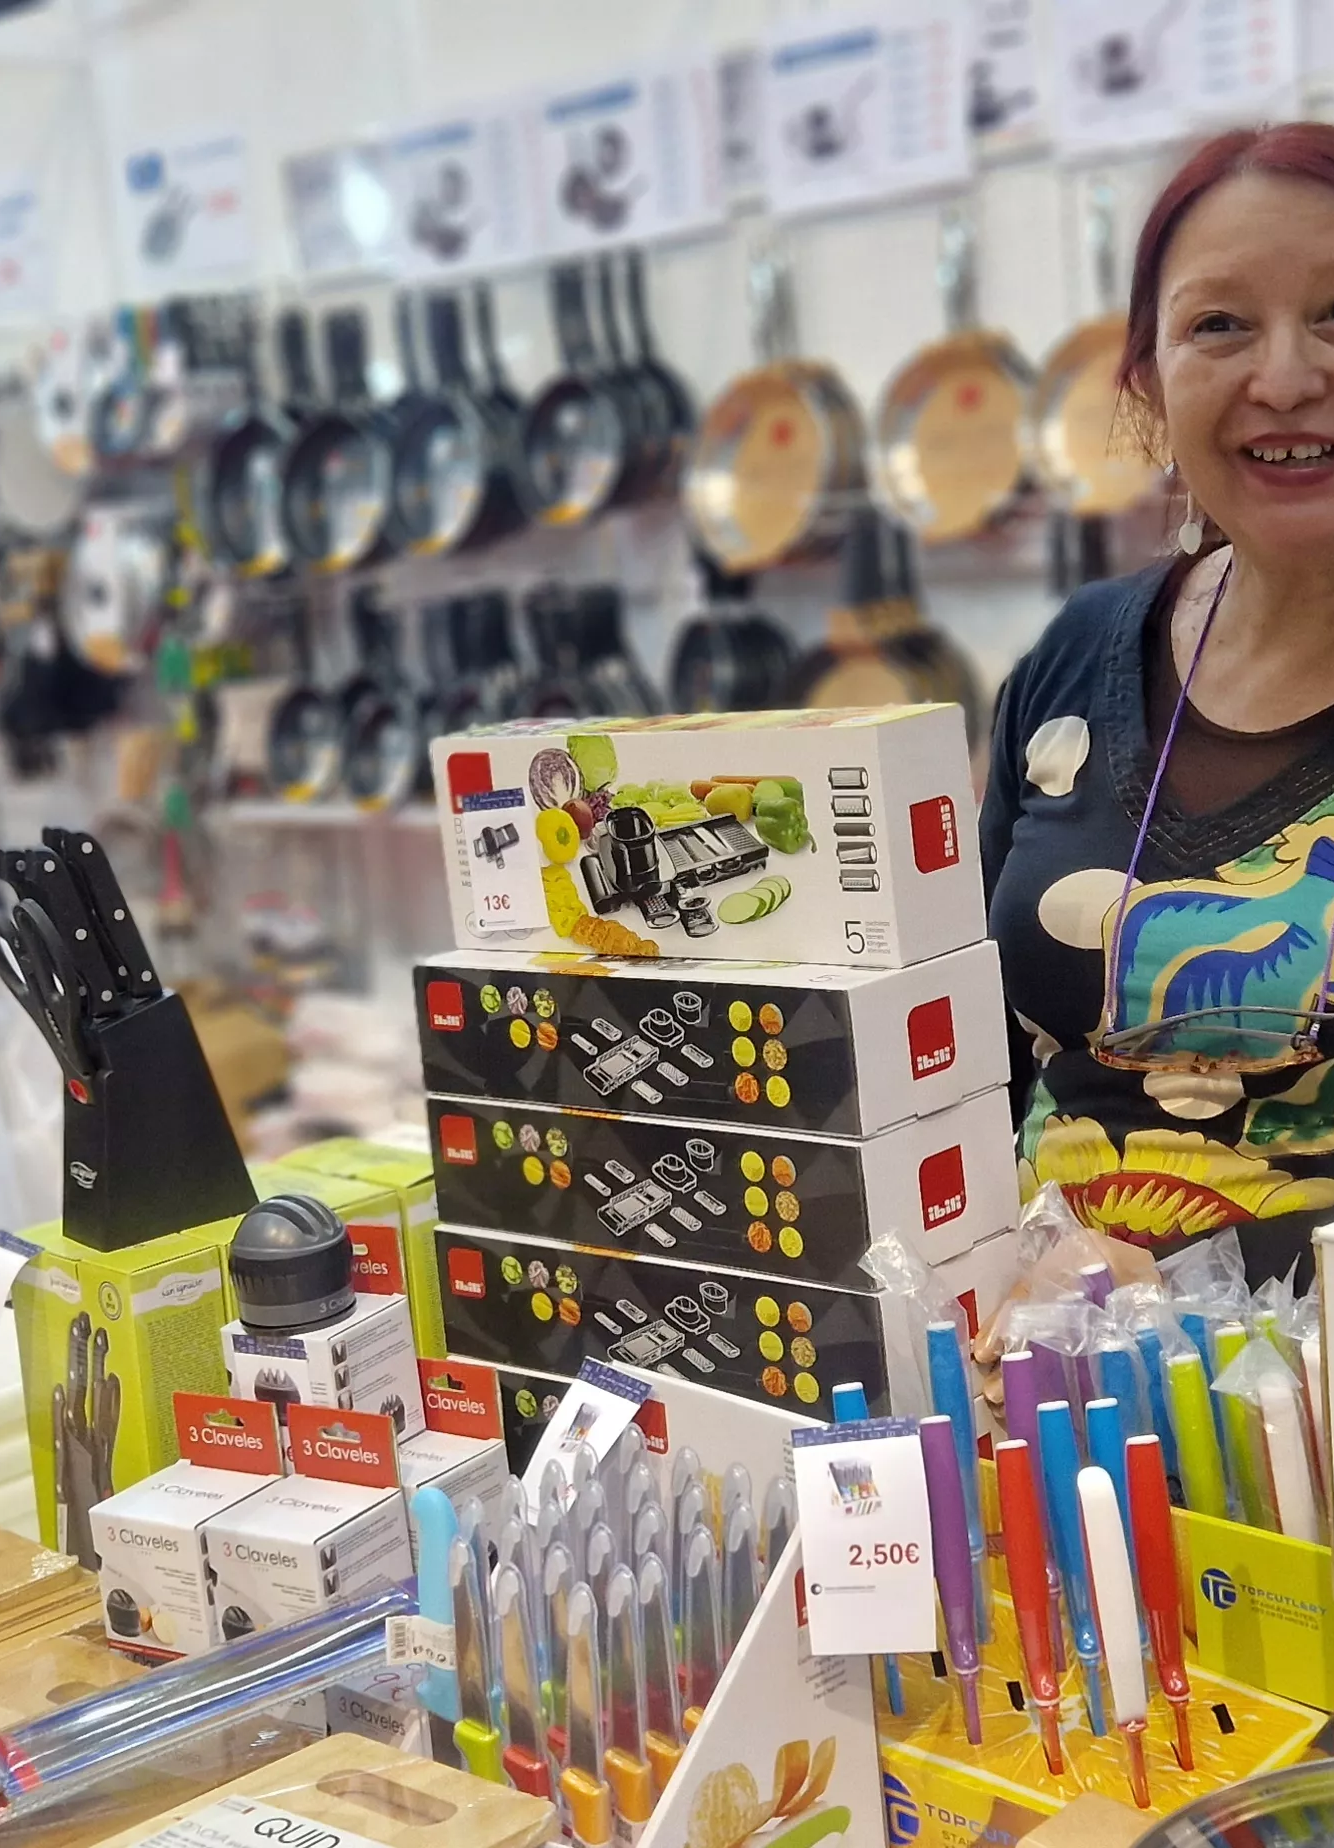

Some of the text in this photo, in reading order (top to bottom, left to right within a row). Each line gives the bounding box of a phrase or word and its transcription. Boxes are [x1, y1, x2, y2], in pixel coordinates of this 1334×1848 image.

[940, 802, 955, 858] ibili
[483, 894, 511, 911] 13€
[844, 920, 865, 954] 5
[433, 1013, 460, 1026] ibili
[917, 1046, 951, 1072] ibili
[447, 1147, 474, 1160] ibili
[928, 1194, 962, 1222] ibili
[351, 1262, 389, 1275] veles
[454, 1279, 482, 1294] ibili
[427, 1392, 486, 1416] Claveles
[189, 1426, 264, 1450] 3 Claveles
[302, 1440, 380, 1465] 3 Claveles
[162, 1484, 226, 1500] Claveles
[278, 1497, 343, 1515] Claveles
[107, 1526, 180, 1552] 3 Claveles
[223, 1542, 298, 1569] 3 Claveles
[849, 1542, 920, 1570] 2,50€
[339, 1696, 406, 1736] 3 Claveles
